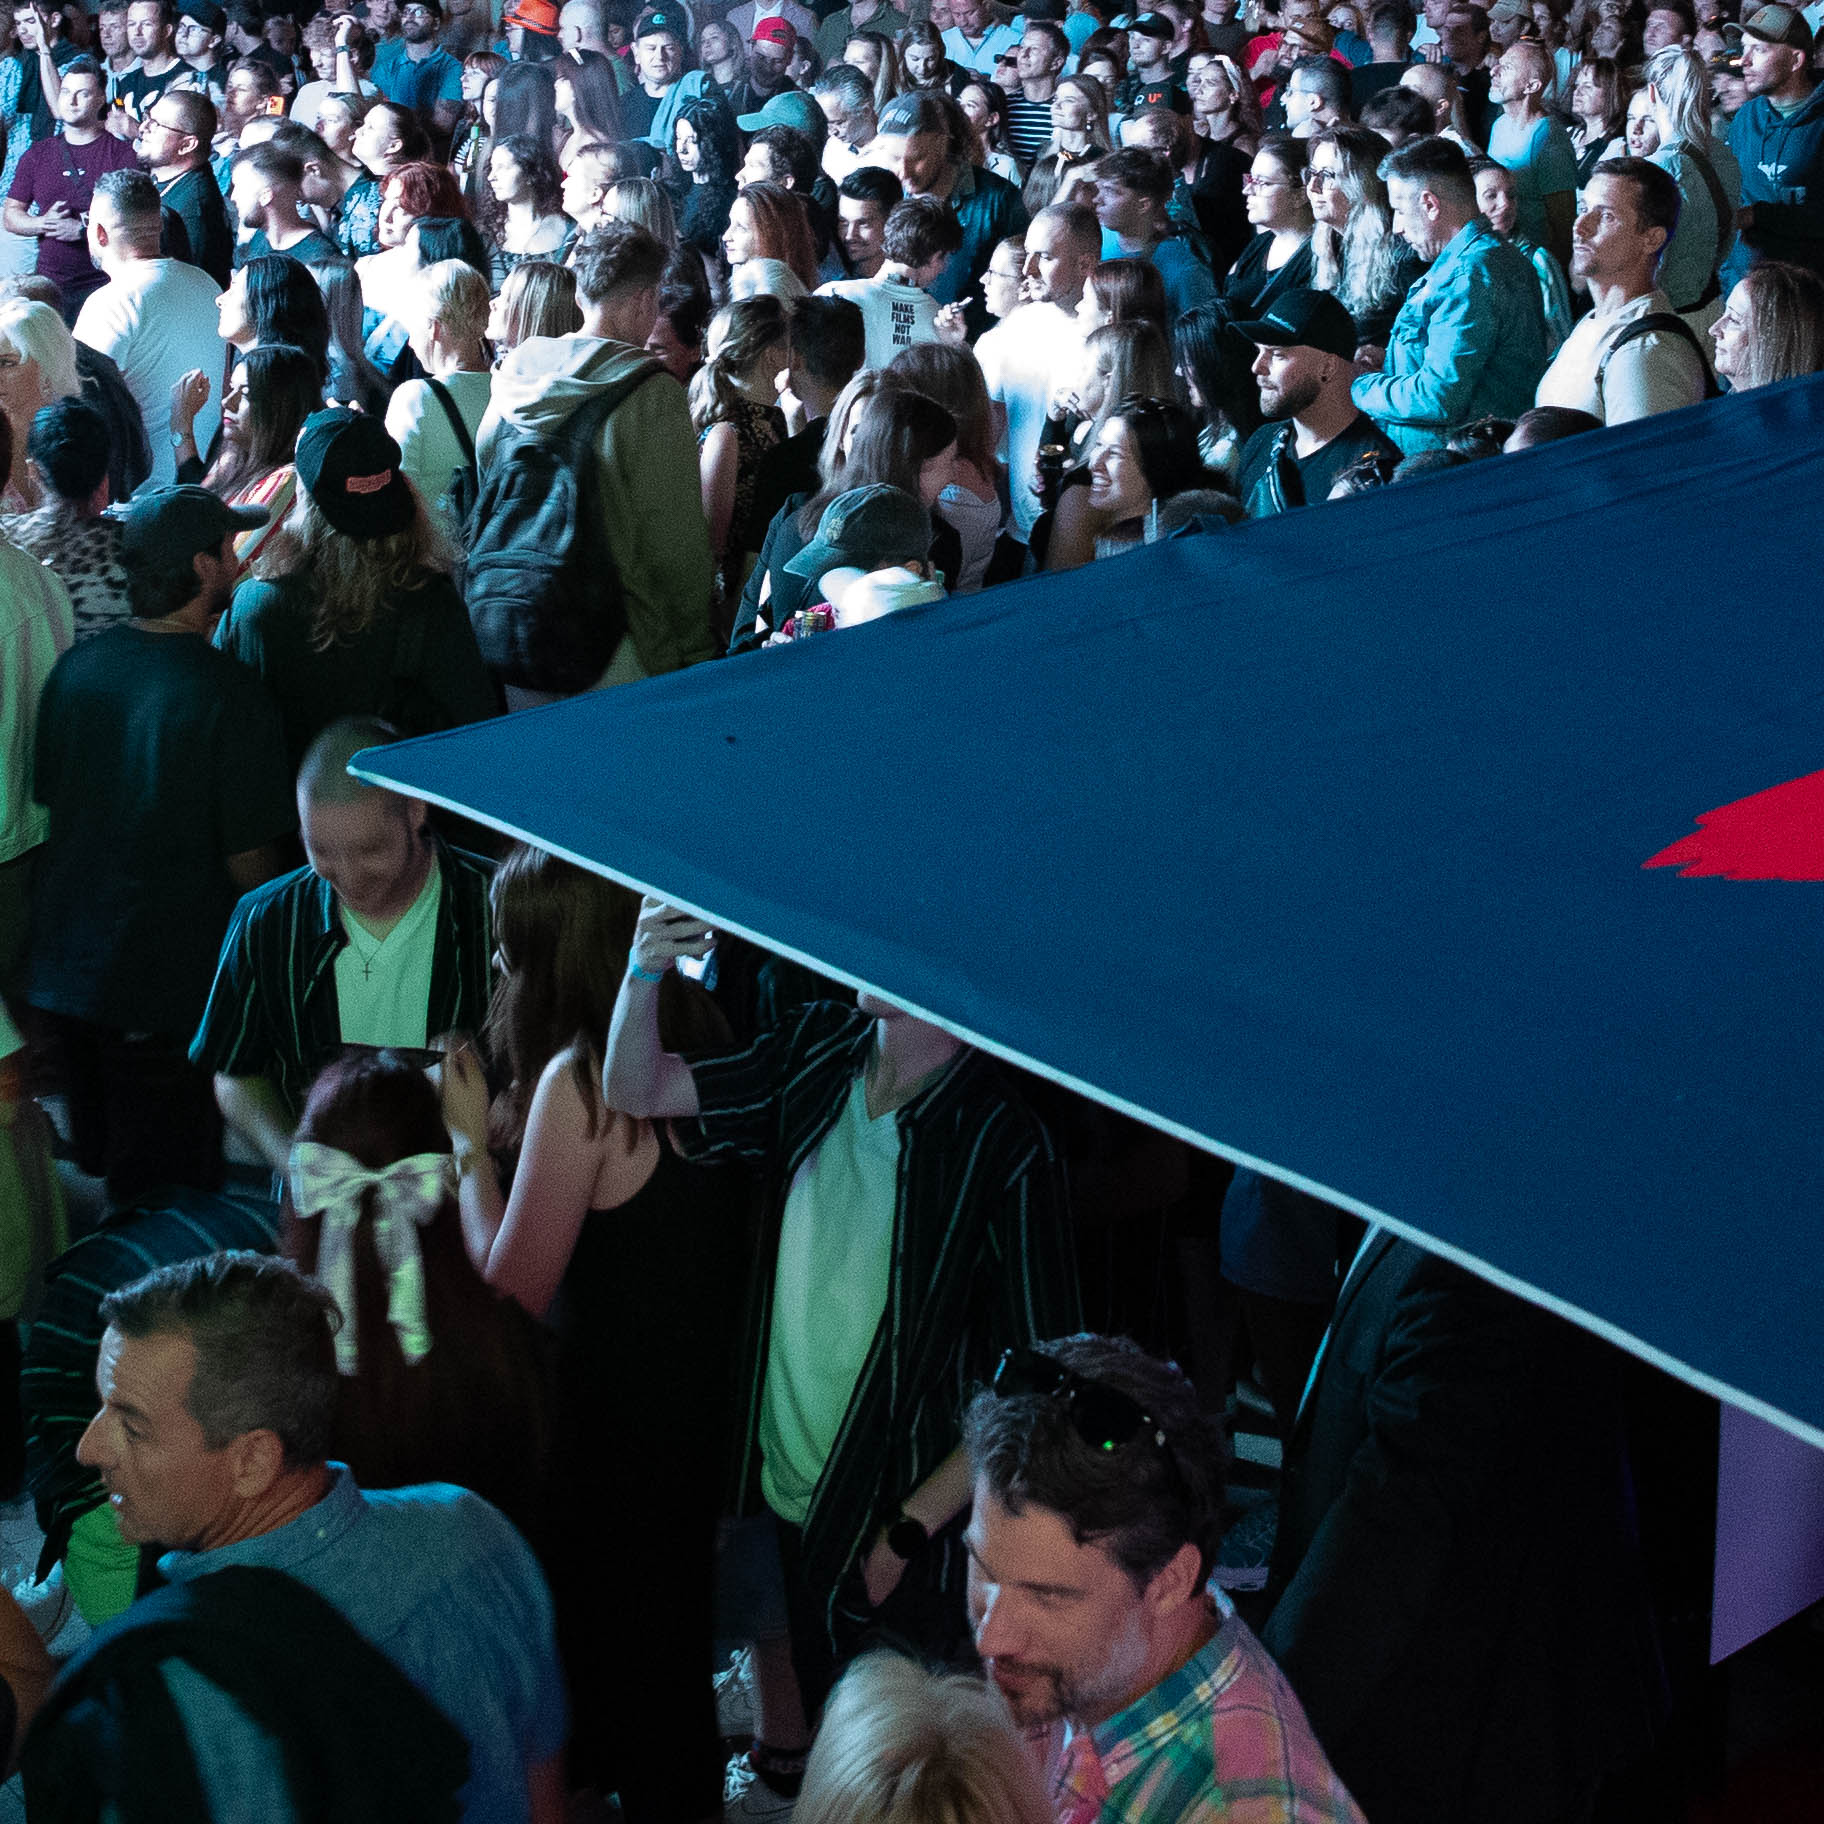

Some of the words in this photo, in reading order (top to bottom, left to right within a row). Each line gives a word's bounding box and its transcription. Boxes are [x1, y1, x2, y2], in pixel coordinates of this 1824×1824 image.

[891, 301, 915, 313] MAKE
[891, 312, 916, 325] FILMS
[894, 323, 911, 334] NOT
[892, 334, 912, 346] WAR
